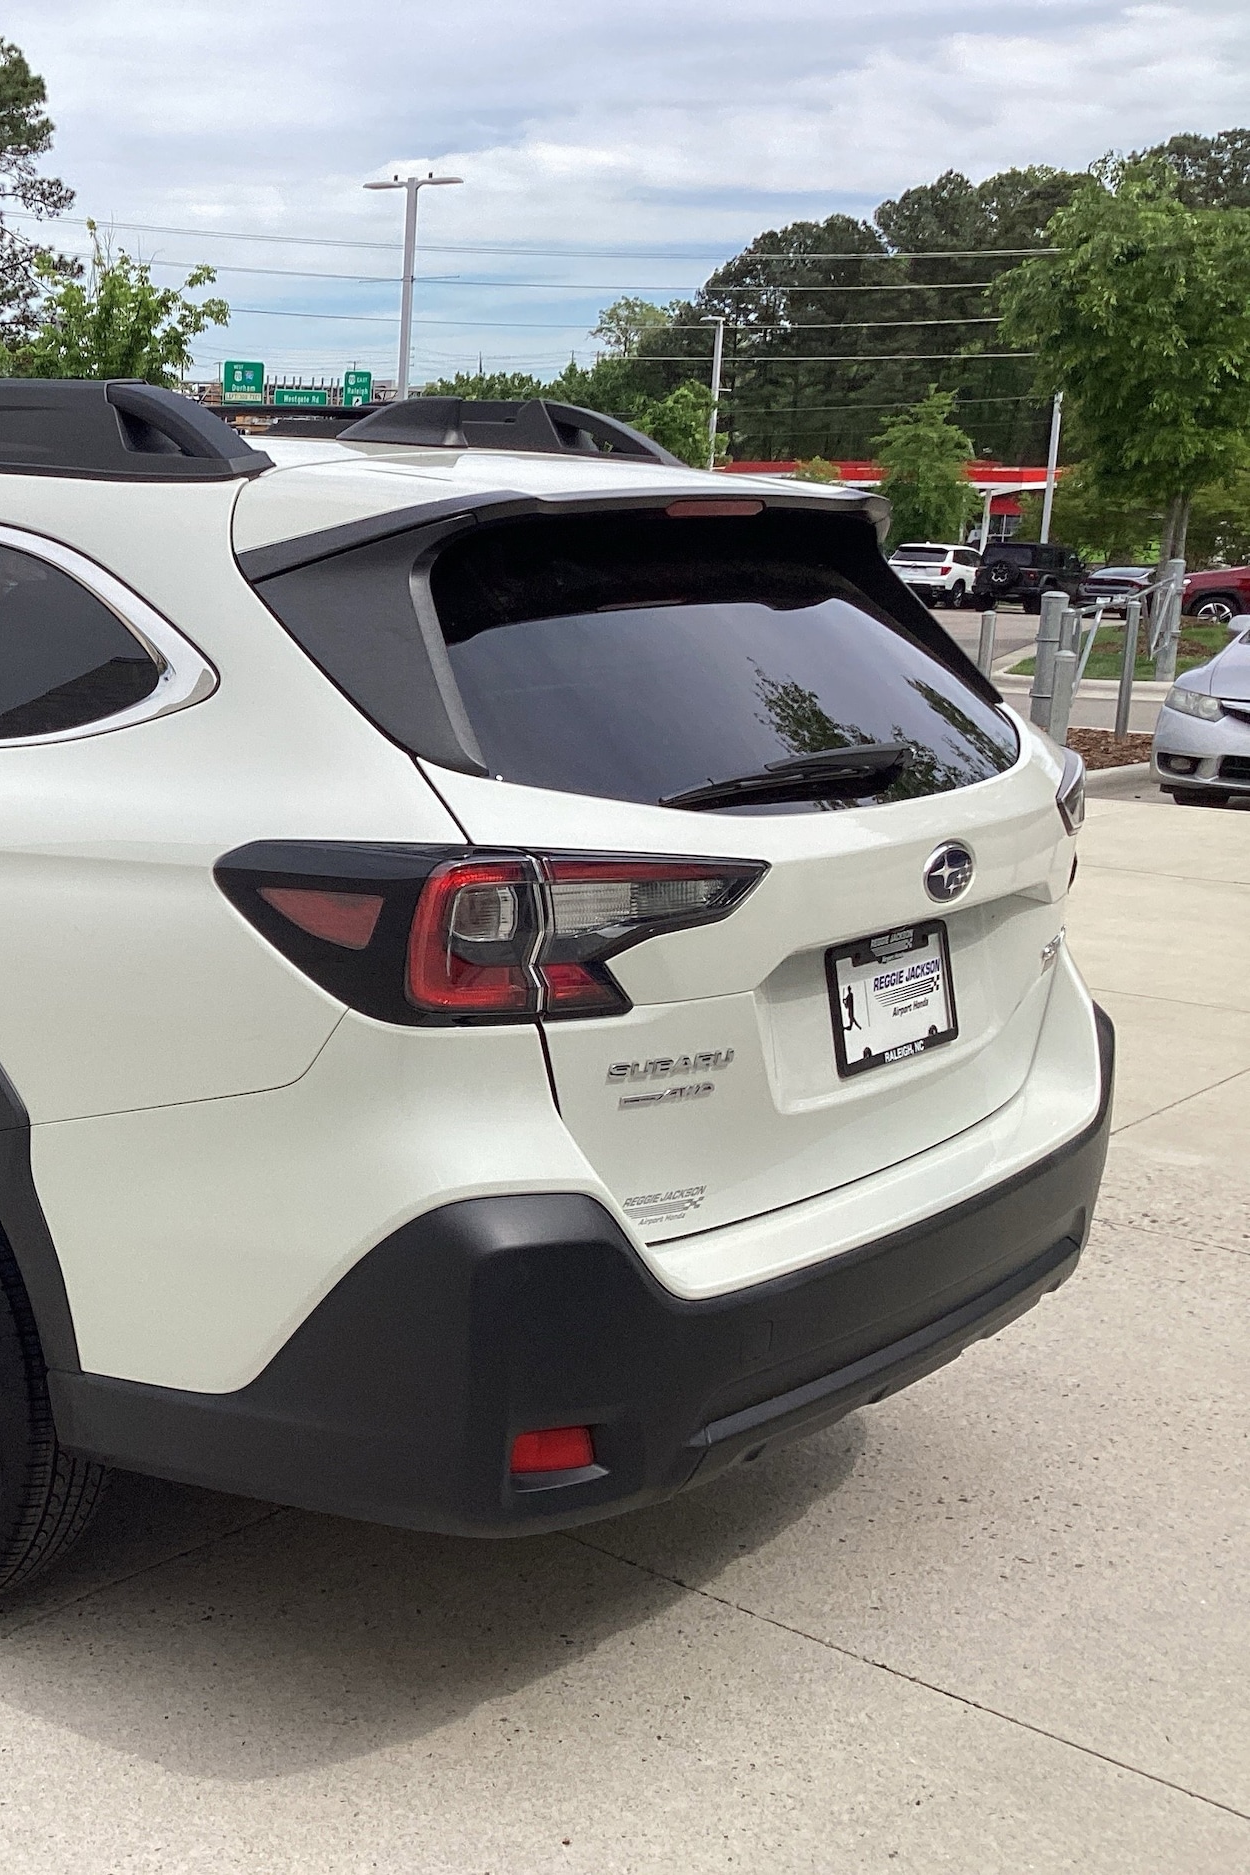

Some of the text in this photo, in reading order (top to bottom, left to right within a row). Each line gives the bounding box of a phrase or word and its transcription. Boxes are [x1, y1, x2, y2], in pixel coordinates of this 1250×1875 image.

[232, 384, 256, 392] Durham
[347, 387, 368, 395] Raleigh
[283, 394, 320, 405] Westgate Rd
[873, 958, 940, 992] REGGIE JACKSON
[892, 998, 929, 1018] Airport Honda
[914, 1040, 925, 1053] NC
[606, 1048, 735, 1083] SUBARU
[622, 1185, 708, 1208] REGGIE JACKSON
[638, 1212, 686, 1226] Airport Honda
